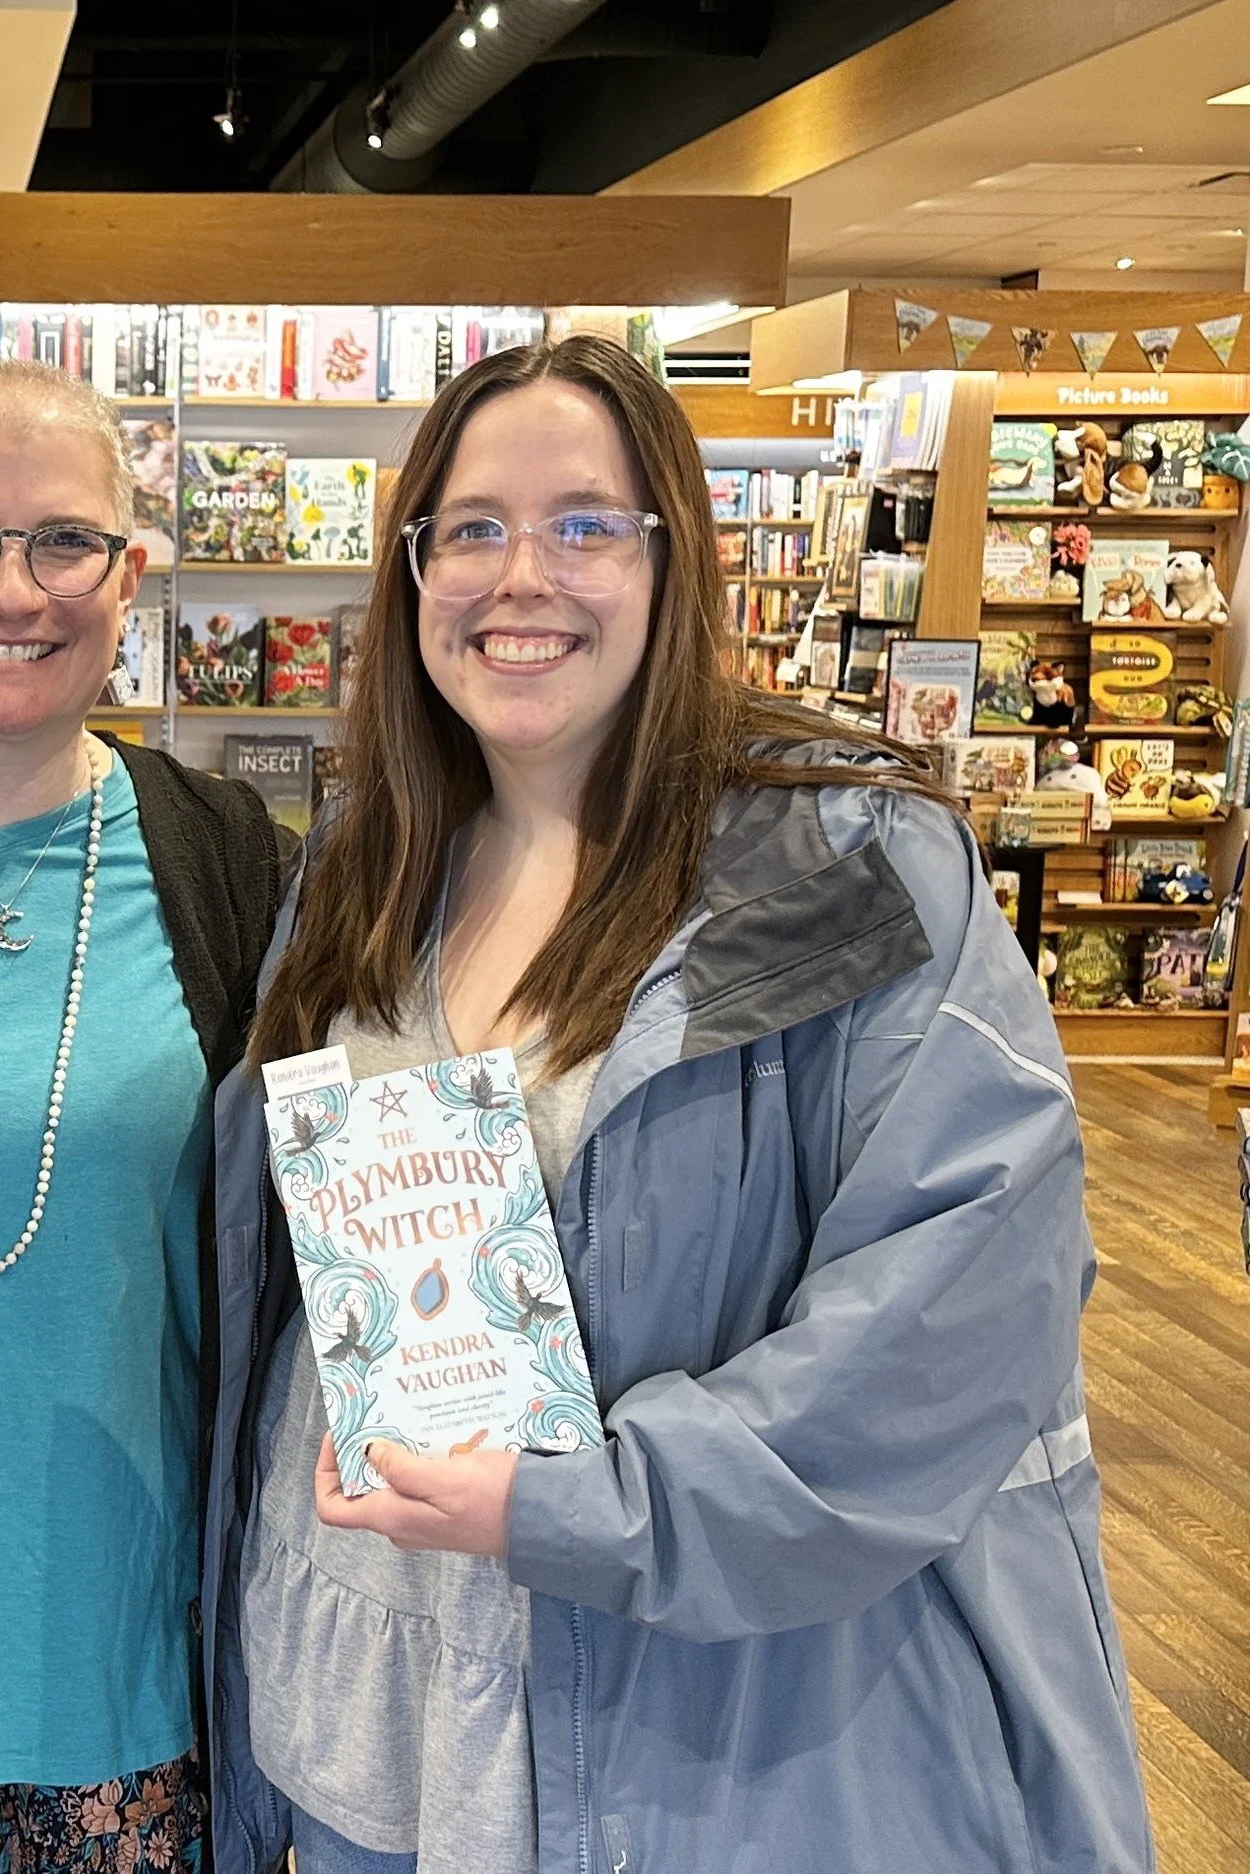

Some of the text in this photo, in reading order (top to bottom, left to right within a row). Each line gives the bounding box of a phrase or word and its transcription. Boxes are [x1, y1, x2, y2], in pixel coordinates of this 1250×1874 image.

[1056, 385, 1169, 405] Picture Books
[191, 490, 276, 509] GARDEN
[238, 754, 303, 773] INSECT
[377, 1127, 418, 1150] THE
[309, 1149, 509, 1233] PLYMBURY
[344, 1197, 487, 1255] WITCH
[400, 1331, 495, 1366] KENDRA
[395, 1356, 508, 1394] VAUGHAN
